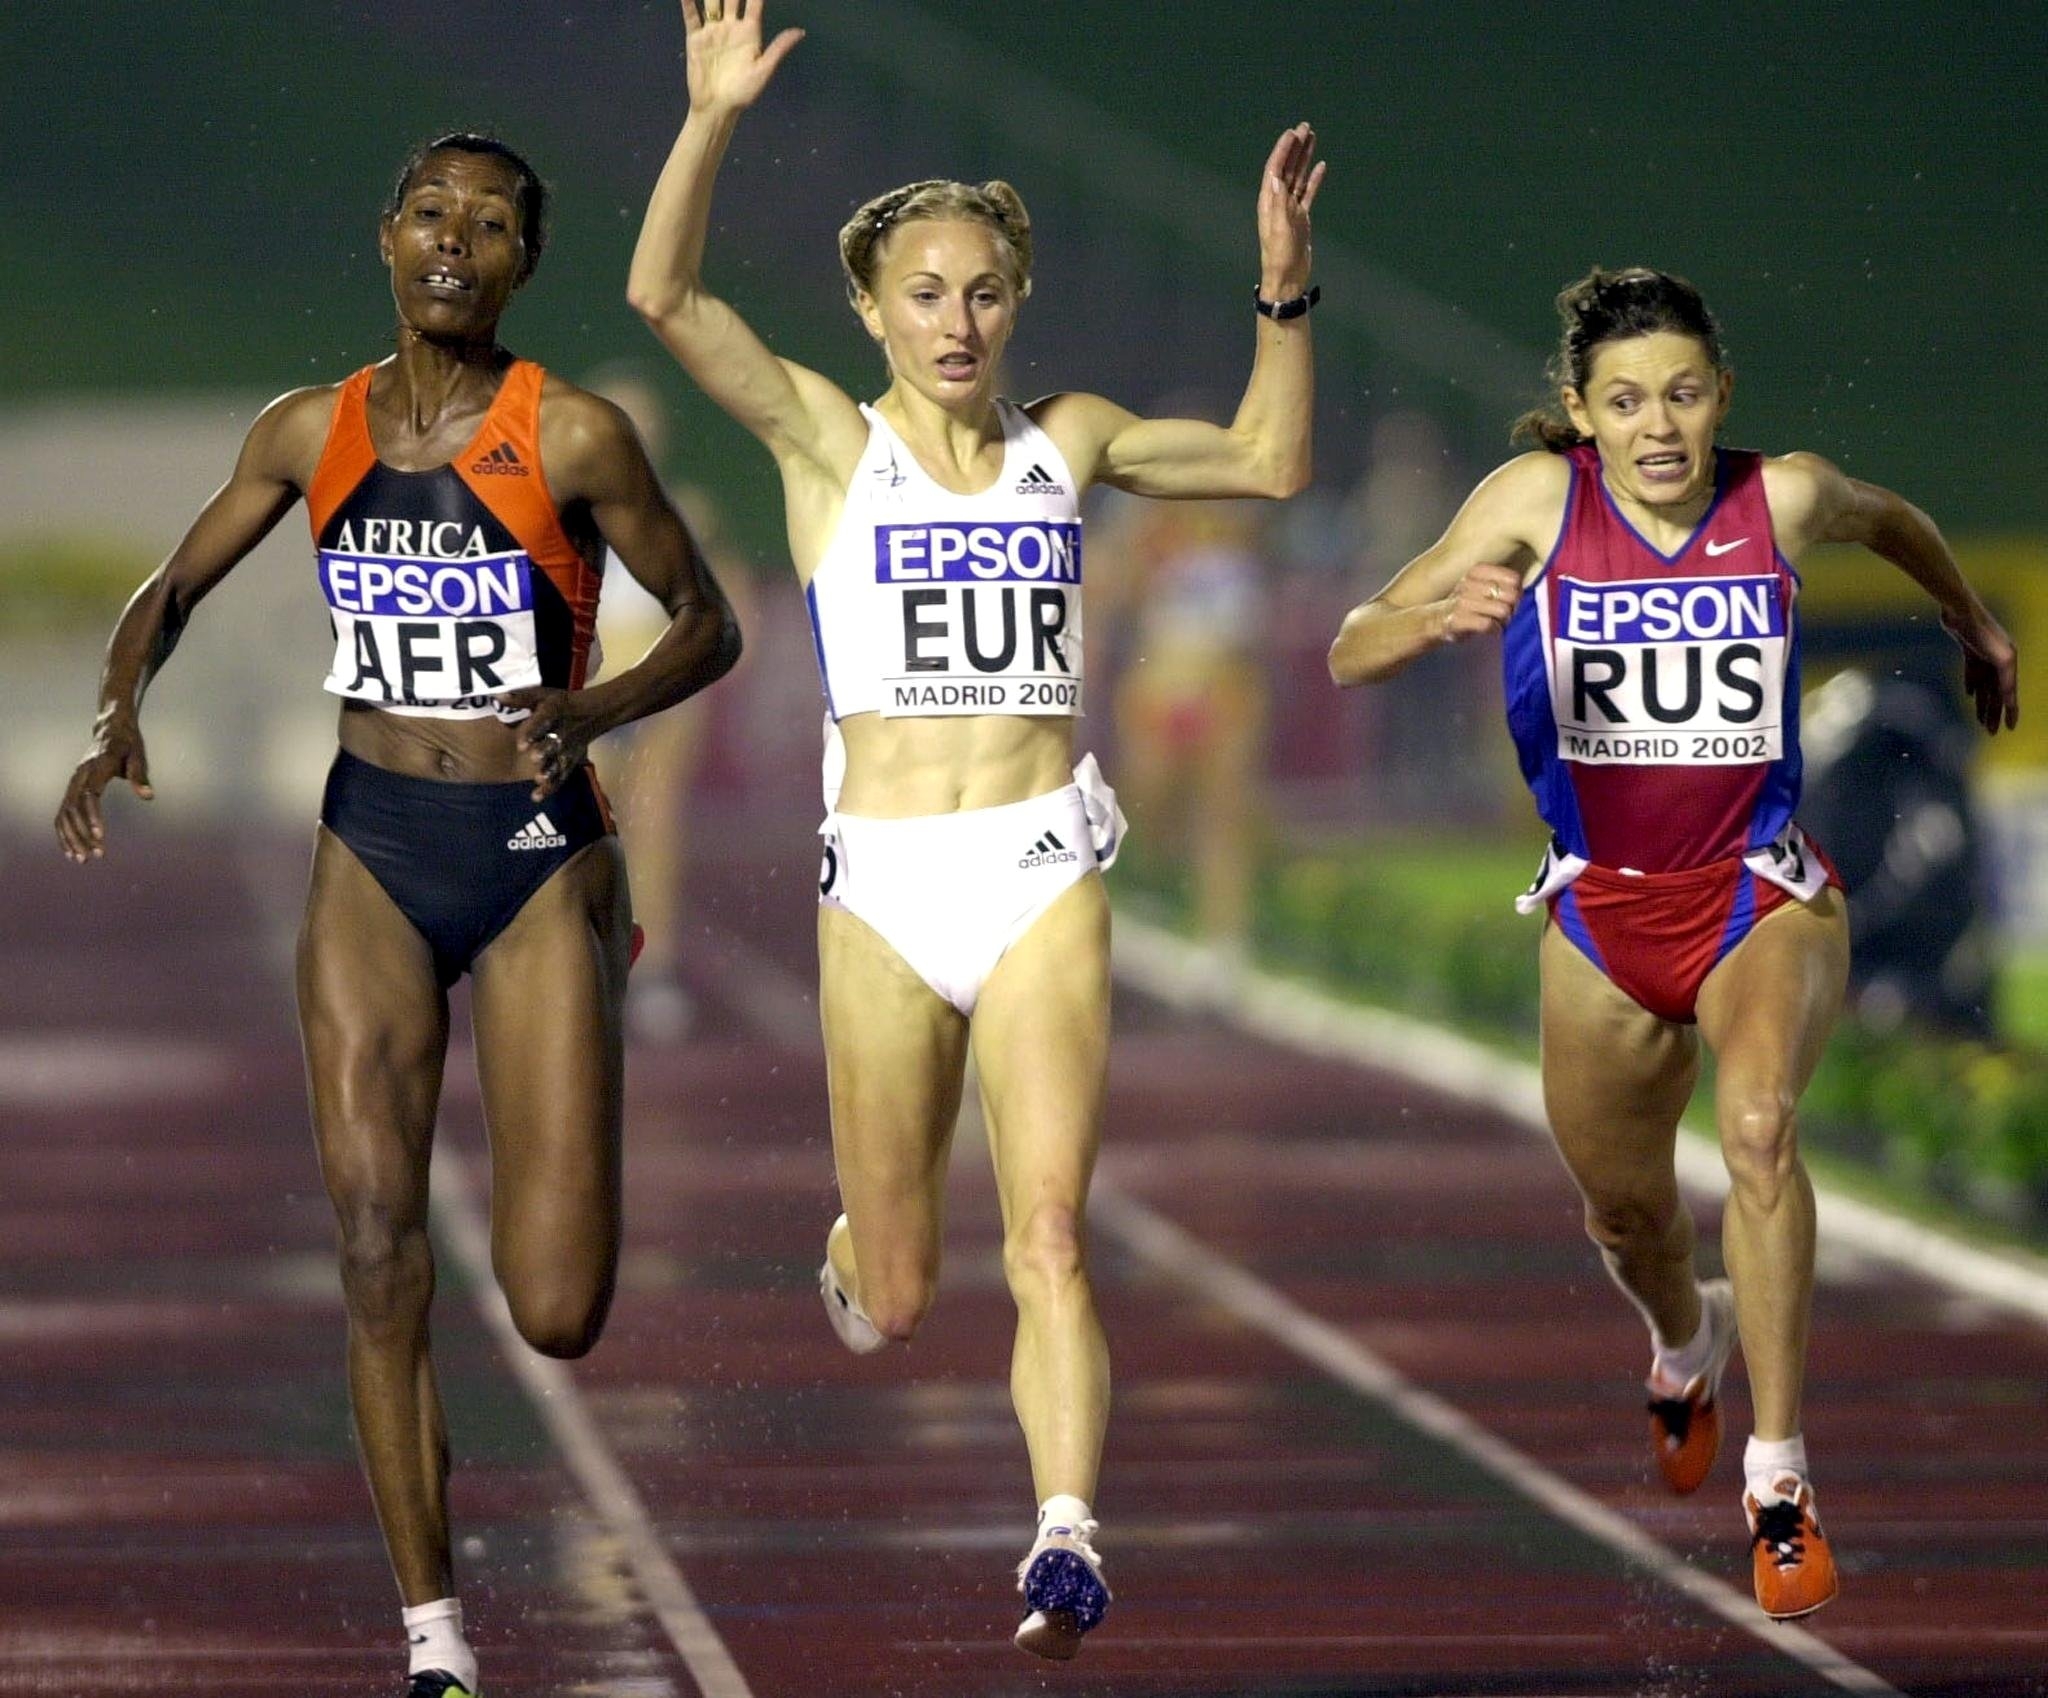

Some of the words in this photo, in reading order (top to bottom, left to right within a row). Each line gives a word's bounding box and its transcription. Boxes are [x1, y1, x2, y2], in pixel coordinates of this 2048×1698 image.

[472, 462, 529, 476] adidas
[1016, 482, 1065, 495] adidas
[336, 518, 489, 557] AFRICA
[888, 526, 1076, 580] EPSON
[328, 559, 522, 616] EPSON
[902, 587, 1070, 673] EUR
[1567, 585, 1771, 640] EPSON
[347, 620, 506, 702] AFR
[894, 685, 1006, 706] MADRID
[1018, 683, 1077, 706] 2002
[1572, 643, 1764, 724] RUS
[1570, 738, 1679, 758] MADRID
[1690, 735, 1767, 758] 2002
[507, 834, 567, 850] adidas
[1018, 851, 1078, 869] adidas
